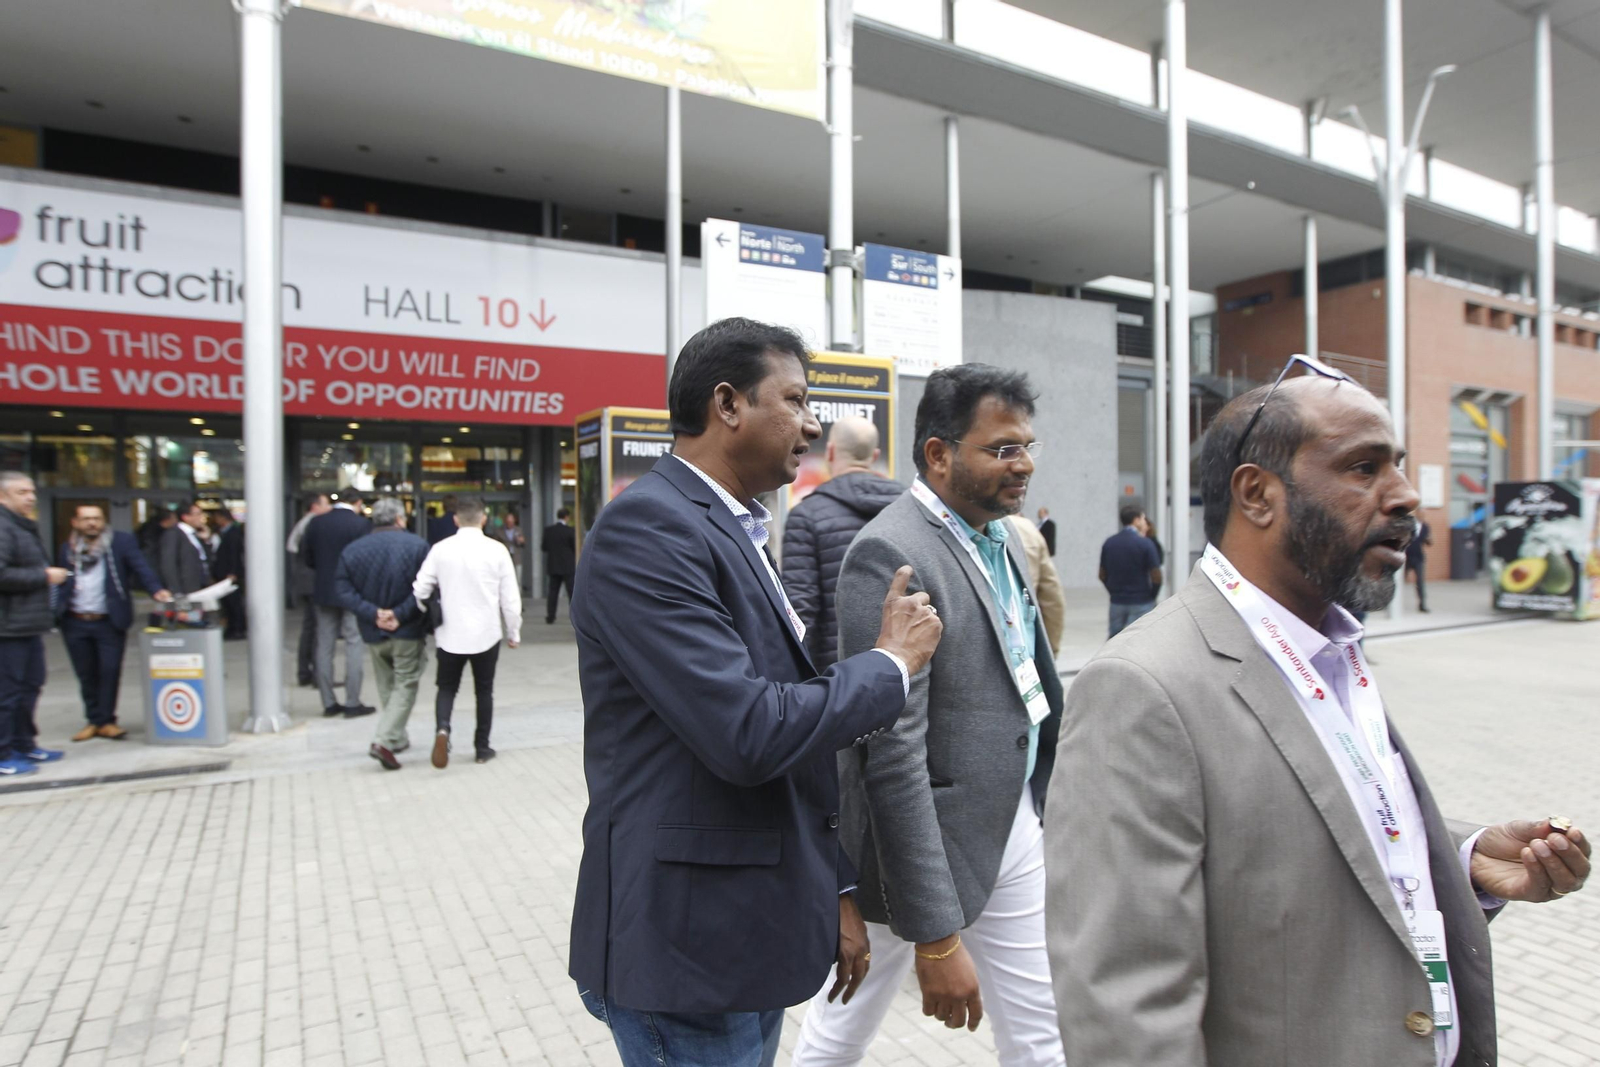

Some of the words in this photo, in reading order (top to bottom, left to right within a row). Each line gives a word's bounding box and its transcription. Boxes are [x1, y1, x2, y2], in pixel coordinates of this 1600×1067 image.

[475, 26, 507, 46] en
[534, 36, 595, 65] Stand
[35, 204, 148, 251] fruit
[741, 236, 772, 250] Norte
[777, 241, 805, 255] North
[35, 254, 302, 310] attractin
[364, 284, 462, 324] HALL
[477, 296, 520, 329] 10
[99, 328, 183, 362] THIS
[193, 335, 308, 369] DOR
[317, 344, 389, 374] YOU
[399, 350, 465, 378] WILL
[474, 355, 541, 382] FIND
[110, 368, 244, 400] WORLD
[325, 380, 564, 415] OPPORTUNITIES
[808, 401, 876, 424] FRUNET
[623, 441, 672, 457] FRUNET
[1260, 616, 1281, 639] Agro
[1276, 639, 1317, 689] Santander
[1376, 784, 1396, 826] attraction
[1376, 809, 1389, 826] fruit
